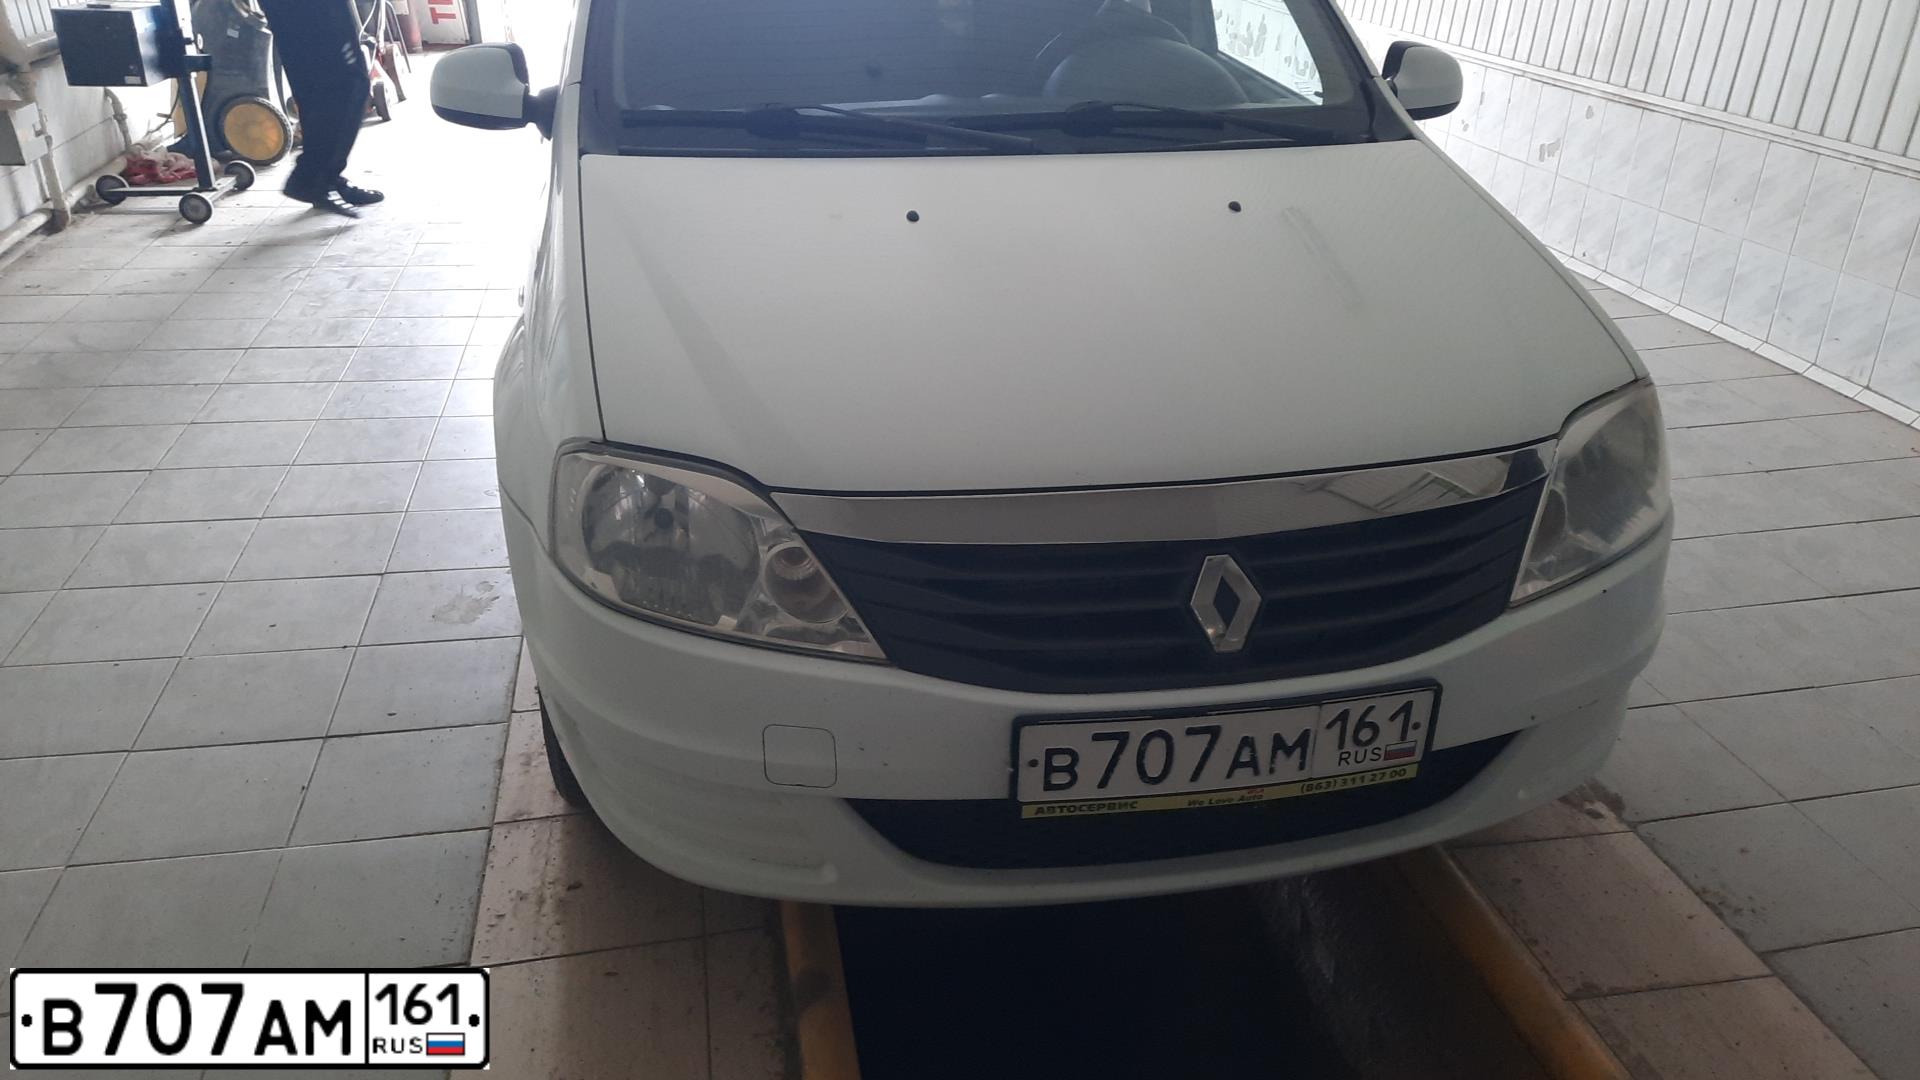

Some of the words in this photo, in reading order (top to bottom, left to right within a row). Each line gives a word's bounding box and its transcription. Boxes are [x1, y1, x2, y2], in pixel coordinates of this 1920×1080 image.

[1325, 700, 1414, 750] 161
[1338, 747, 1382, 767] RUS
[1034, 801, 1138, 816] АВТОСЕРВИС
